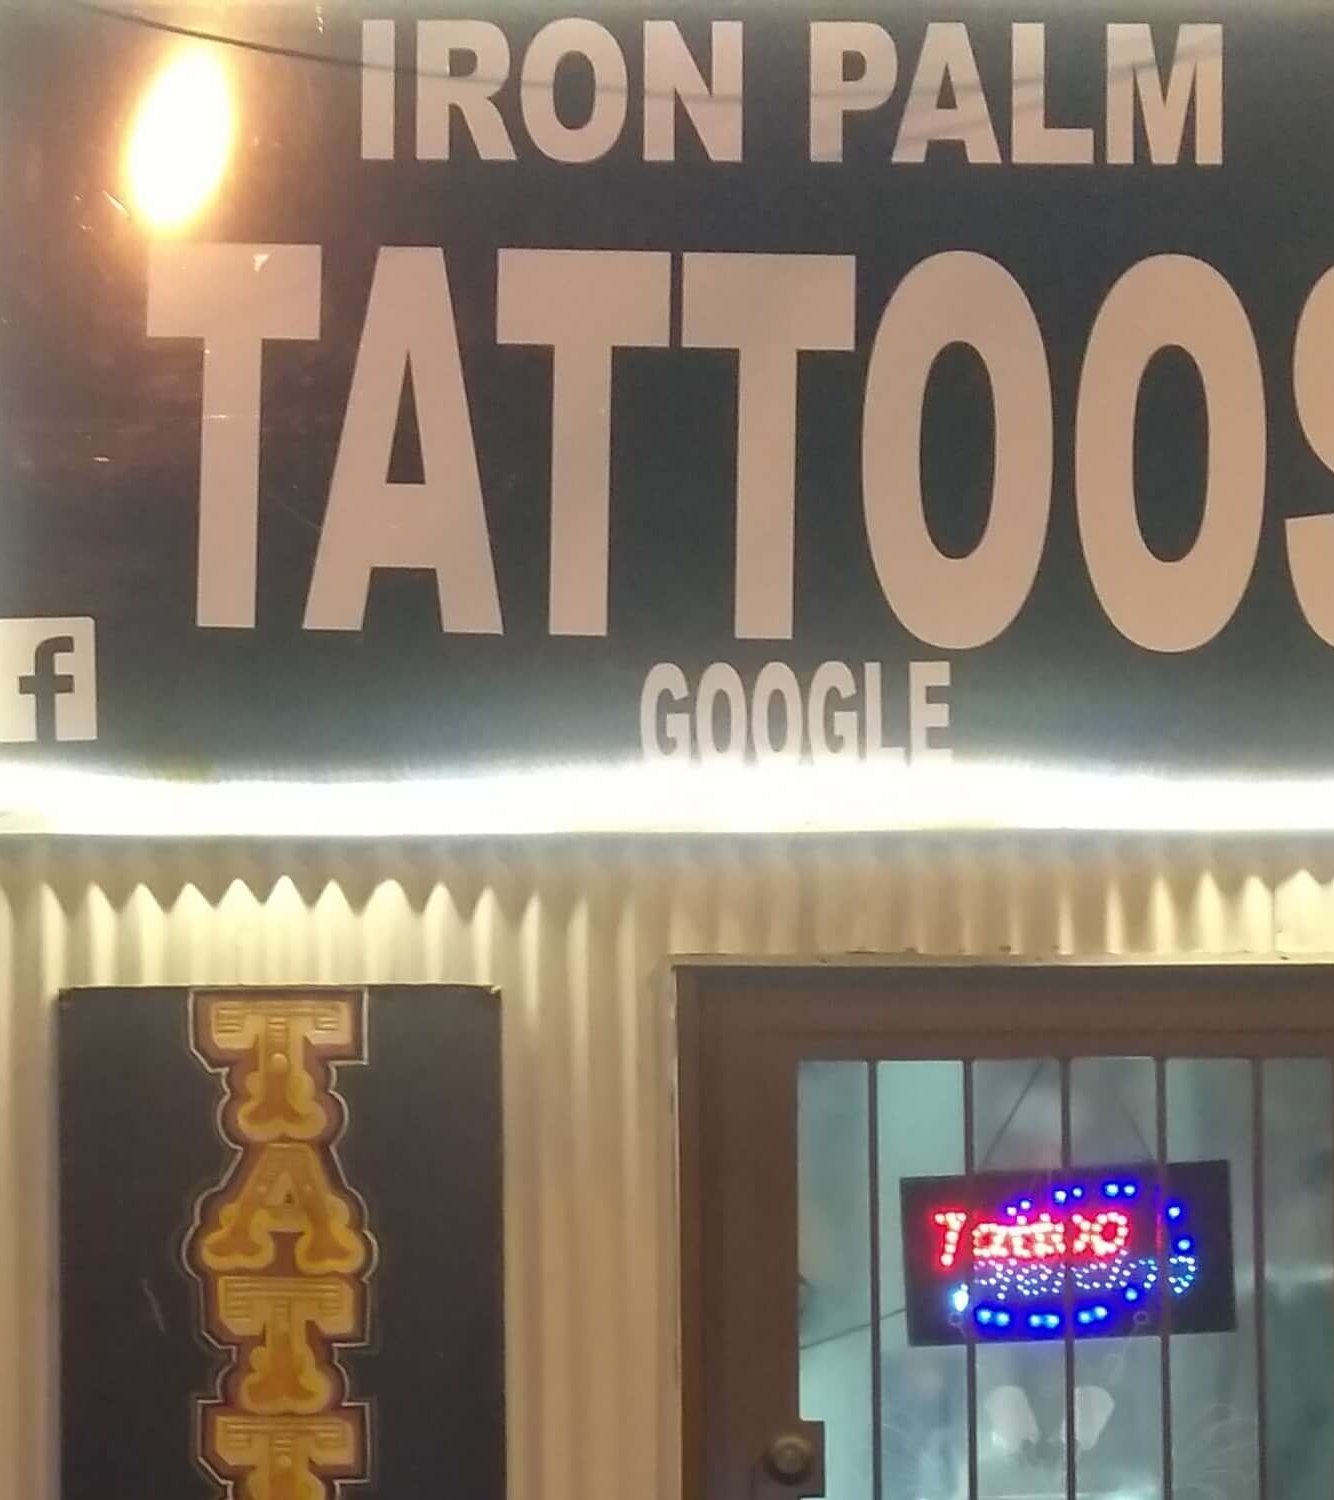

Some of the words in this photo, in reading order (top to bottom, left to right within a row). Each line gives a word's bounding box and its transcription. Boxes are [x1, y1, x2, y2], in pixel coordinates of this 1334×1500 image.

[359, 17, 744, 163] IRON
[808, 20, 1224, 166] PALM
[640, 660, 953, 768] GOOGLE
